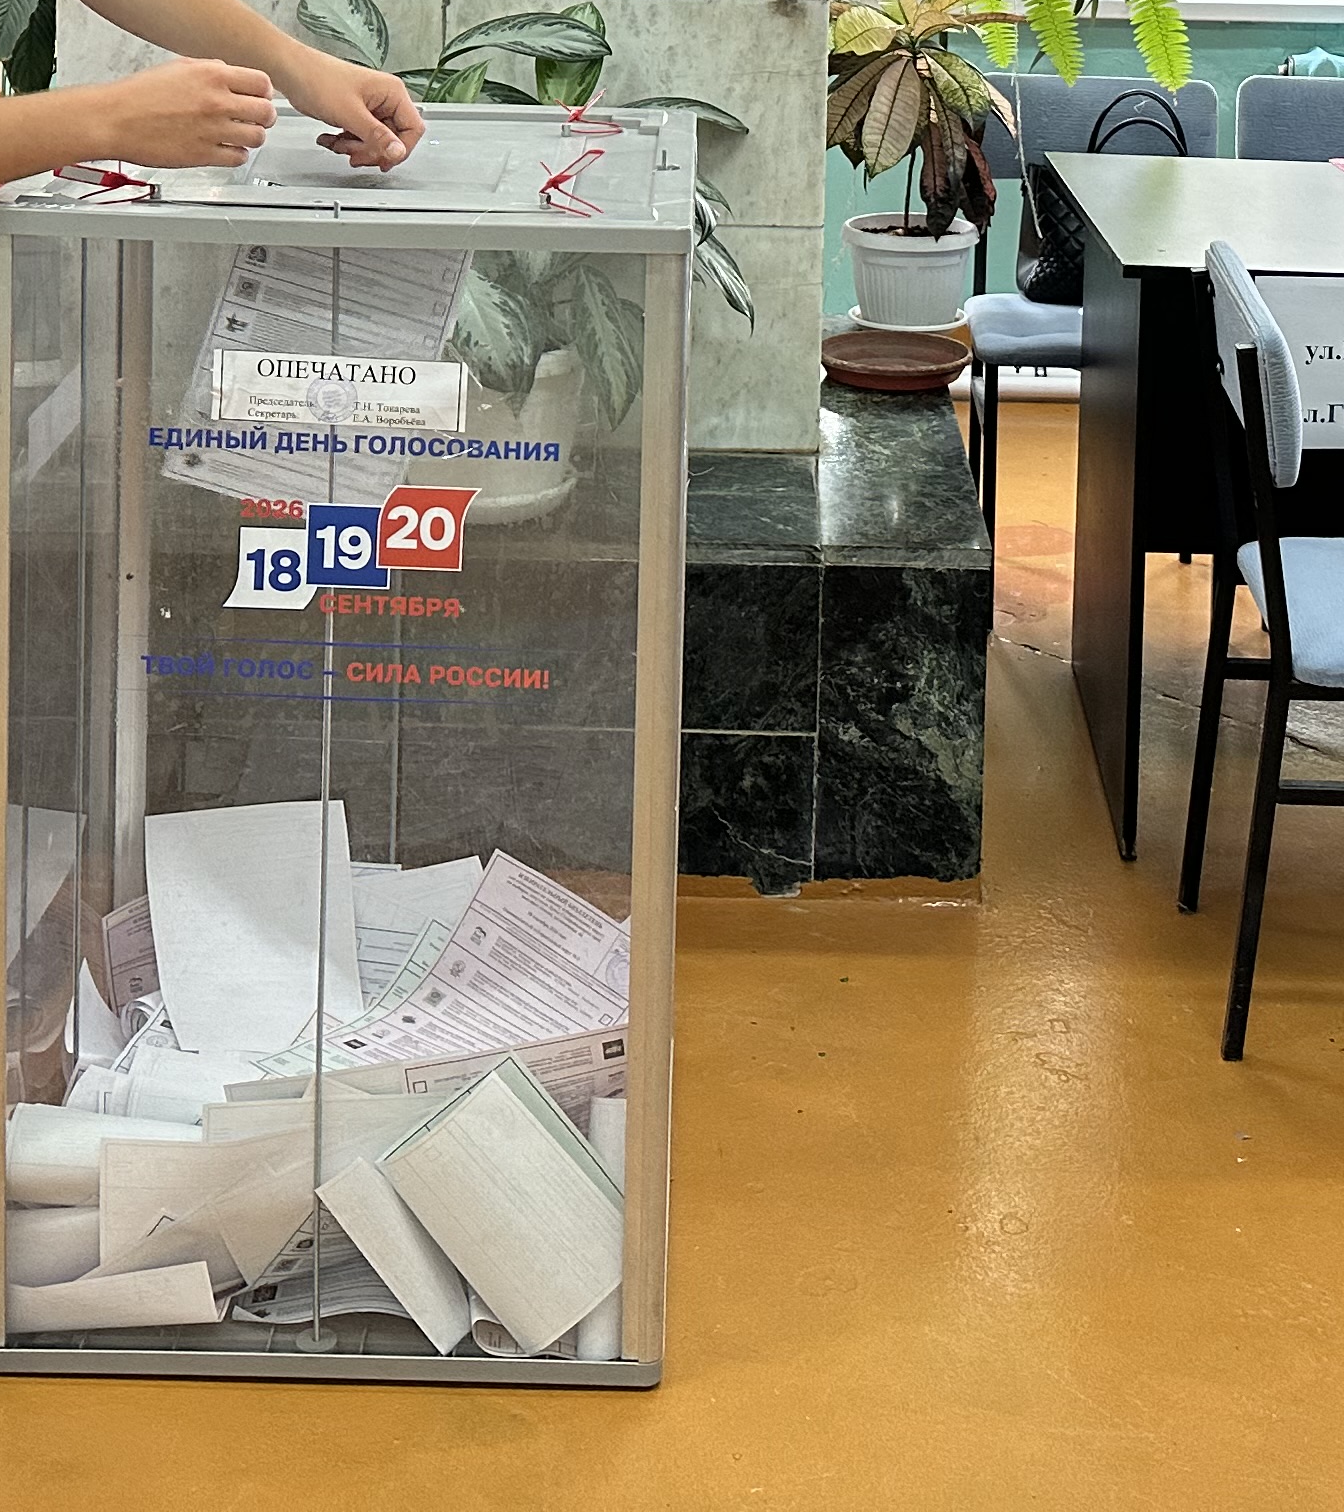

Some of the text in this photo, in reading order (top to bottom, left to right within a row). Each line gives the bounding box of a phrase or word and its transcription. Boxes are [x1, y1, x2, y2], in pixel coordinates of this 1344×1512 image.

[257, 358, 416, 386] ОПЕЧАТАНО
[148, 425, 560, 463] ЕДИНЫЙ ДЕНЬ ГОЛОСОВАНИЯ
[240, 498, 304, 520] 2026
[386, 505, 456, 551] 20
[316, 525, 373, 570] 19
[246, 549, 302, 592] 18
[319, 593, 460, 618] СЕНТЯБРЯ
[140, 651, 215, 677] ТВОЙ
[223, 657, 314, 680] ГОЛОС
[346, 662, 421, 684] СИЛА
[429, 665, 549, 690] РОССИИ!
